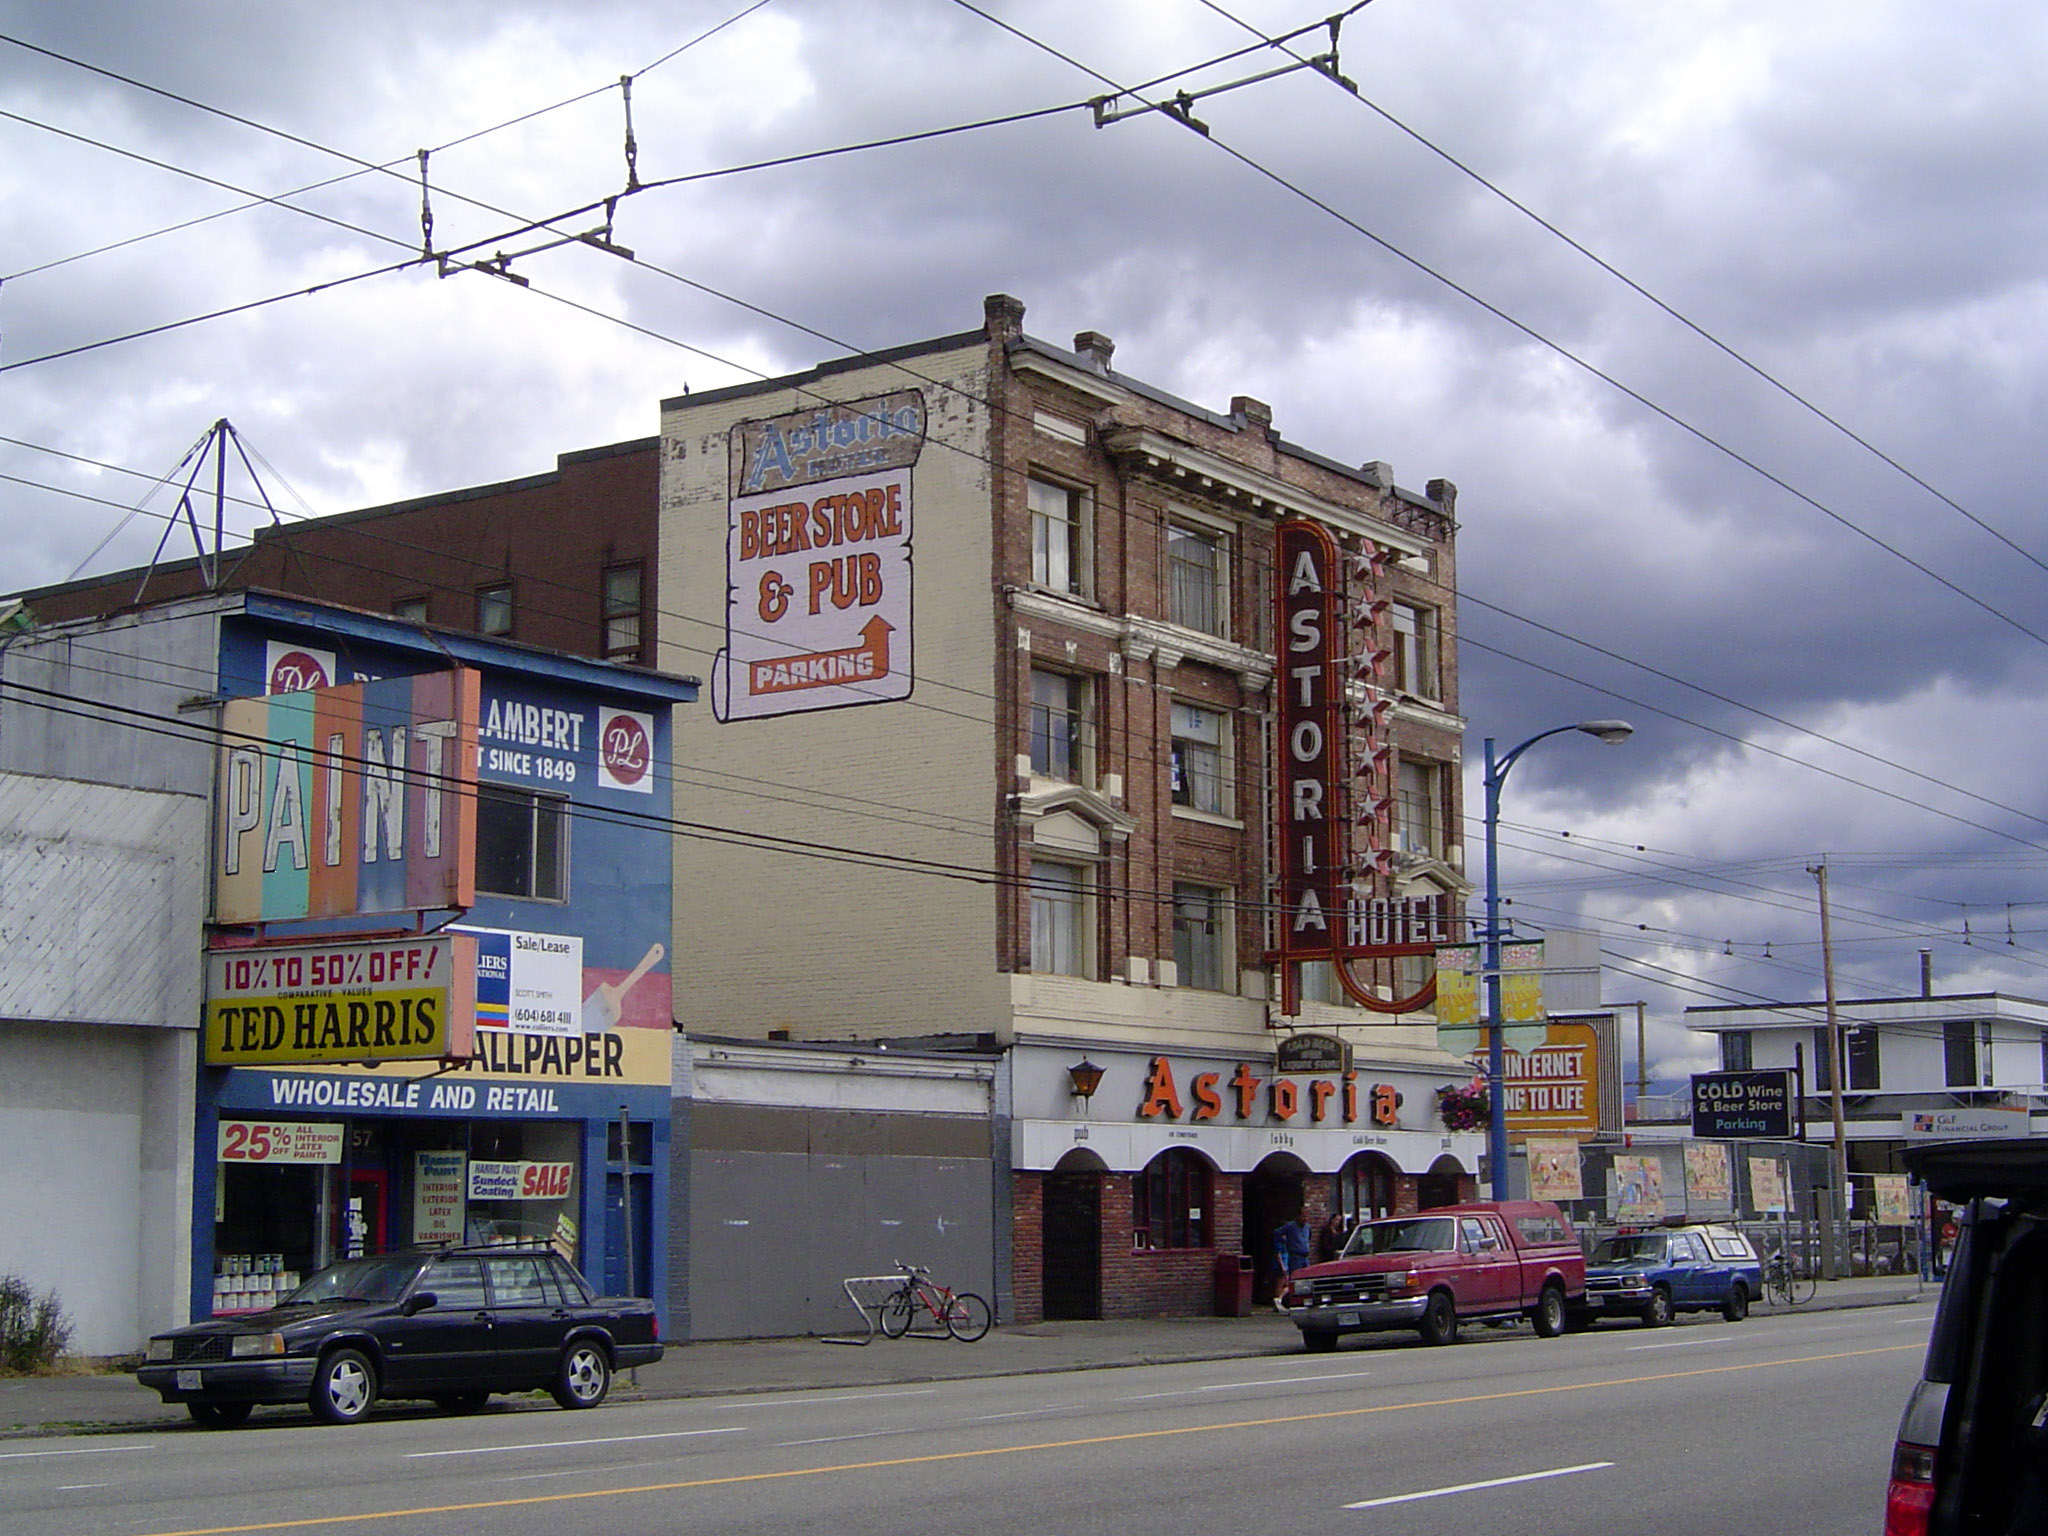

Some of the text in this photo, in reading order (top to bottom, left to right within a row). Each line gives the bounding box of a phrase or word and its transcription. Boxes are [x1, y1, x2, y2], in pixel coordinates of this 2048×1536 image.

[746, 398, 922, 490] Astoria
[739, 483, 903, 562] BEER STORE
[758, 552, 883, 623] & PUB
[756, 650, 874, 690] PARKING
[478, 698, 584, 753] AMBERT
[1287, 550, 1326, 932] ASTORIA
[489, 748, 531, 776] SINCE
[535, 757, 576, 783] 1849
[223, 719, 458, 876] PAINT
[1346, 895, 1448, 946] HOTEL
[515, 935, 571, 954] Sale/Lease
[224, 945, 439, 990] 10% TO 50% OFF!
[277, 987, 373, 1000] COMPARATIVE VALUES
[218, 997, 437, 1053] TED HARRIS
[515, 1008, 539, 1021] (604)
[540, 1010, 556, 1023] 681
[439, 1031, 624, 1077] ALLPAPER
[1504, 1052, 1584, 1078] INTERNET
[271, 1078, 559, 1112] WHOLESALE AND RETAIL
[1138, 1056, 1404, 1126] Astoria
[1528, 1087, 1549, 1111] TO
[1552, 1086, 1585, 1110] LIFE
[1696, 1081, 1783, 1099] COLD Wine
[1699, 1099, 1783, 1113] & Beer Store
[296, 1125, 314, 1133] ALL
[1716, 1118, 1767, 1131] Parking
[272, 1147, 290, 1155] OFF
[294, 1143, 323, 1151] LATEX
[295, 1134, 340, 1143] INTERIOR
[293, 1151, 328, 1159] PAINTS
[423, 1183, 459, 1192] INTERIOR
[472, 1175, 519, 1187] Sundeck
[473, 1186, 515, 1199] Coating
[522, 1165, 571, 1197] SALE
